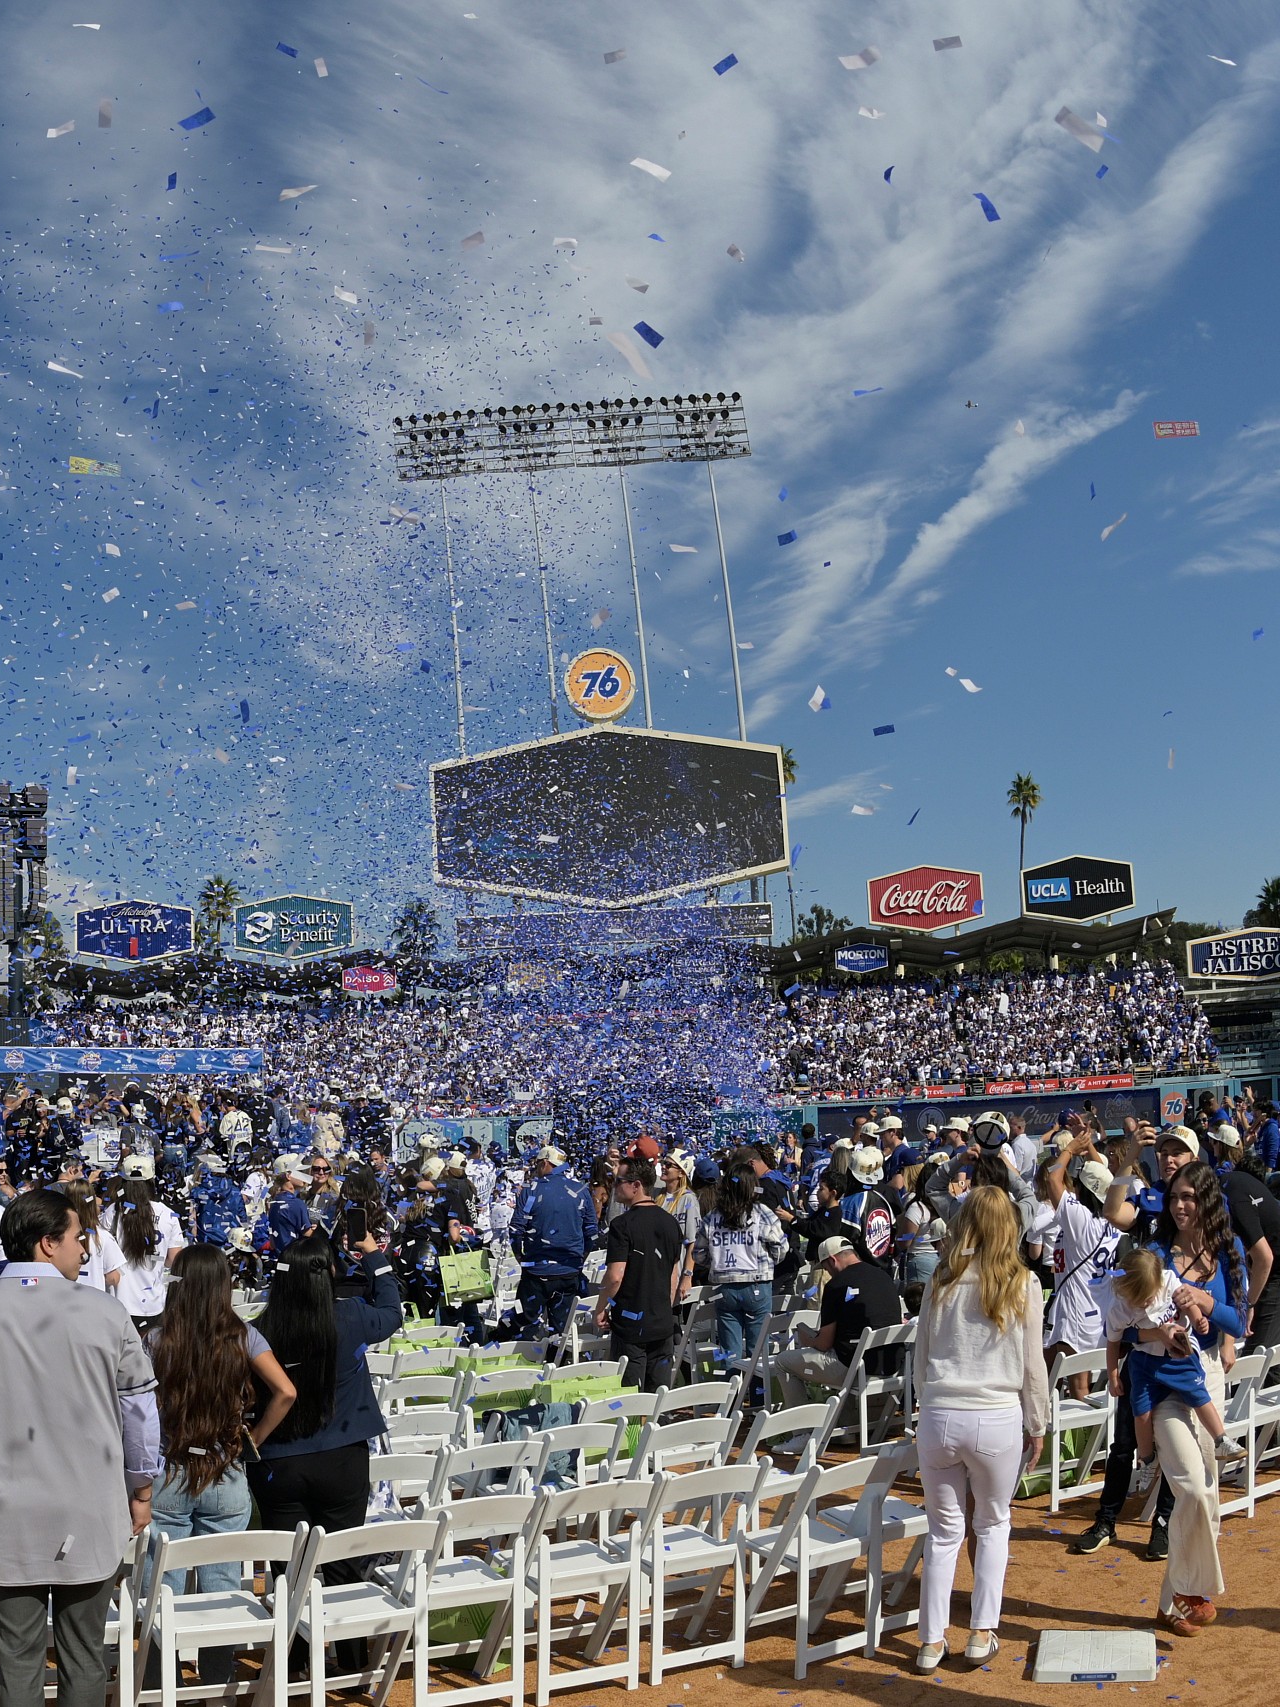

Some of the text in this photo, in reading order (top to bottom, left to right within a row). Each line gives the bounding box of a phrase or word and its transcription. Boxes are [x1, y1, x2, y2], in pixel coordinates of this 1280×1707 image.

[580, 665, 621, 699] 76
[1031, 878, 1126, 898] UCLA Health
[879, 879, 971, 916] Coca-Cola
[101, 918, 168, 934] ULTRA
[280, 910, 342, 927] Security
[280, 927, 334, 942] Benefit
[838, 949, 885, 960] MORTON
[1209, 936, 1280, 957] ESTRE
[345, 975, 380, 983] DAISO
[1165, 1098, 1183, 1115] 76
[712, 1230, 755, 1247] SERIES
[725, 1248, 737, 1268] LA
